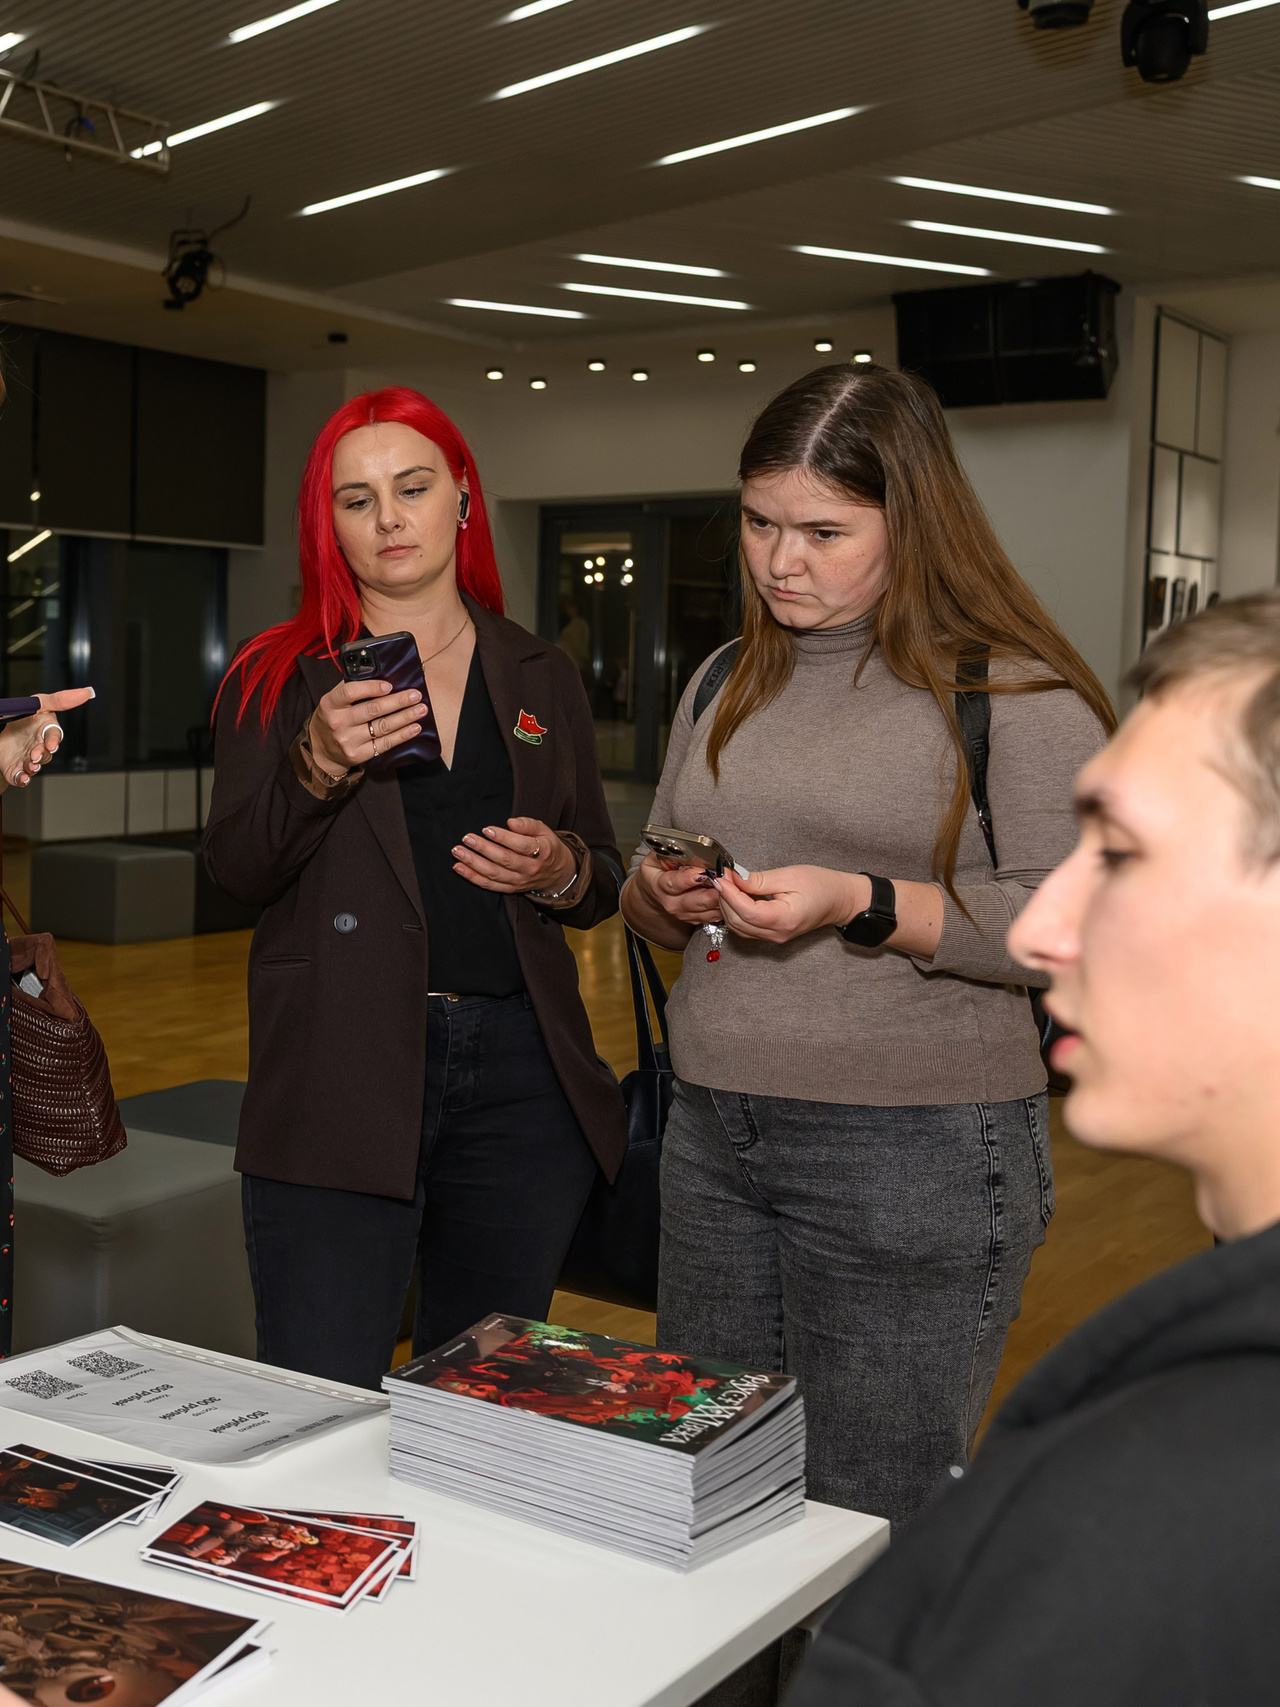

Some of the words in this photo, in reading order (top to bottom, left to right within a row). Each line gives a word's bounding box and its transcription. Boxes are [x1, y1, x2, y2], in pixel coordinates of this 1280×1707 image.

[112, 1390, 151, 1406] рублей
[717, 1374, 771, 1406] ФАУСТ
[196, 1396, 221, 1406] 300
[159, 1402, 199, 1420] рублей
[246, 1410, 269, 1420] 150
[682, 1398, 744, 1428] XXI
[209, 1416, 248, 1434] рублей
[659, 1421, 709, 1444] ВЕКА
